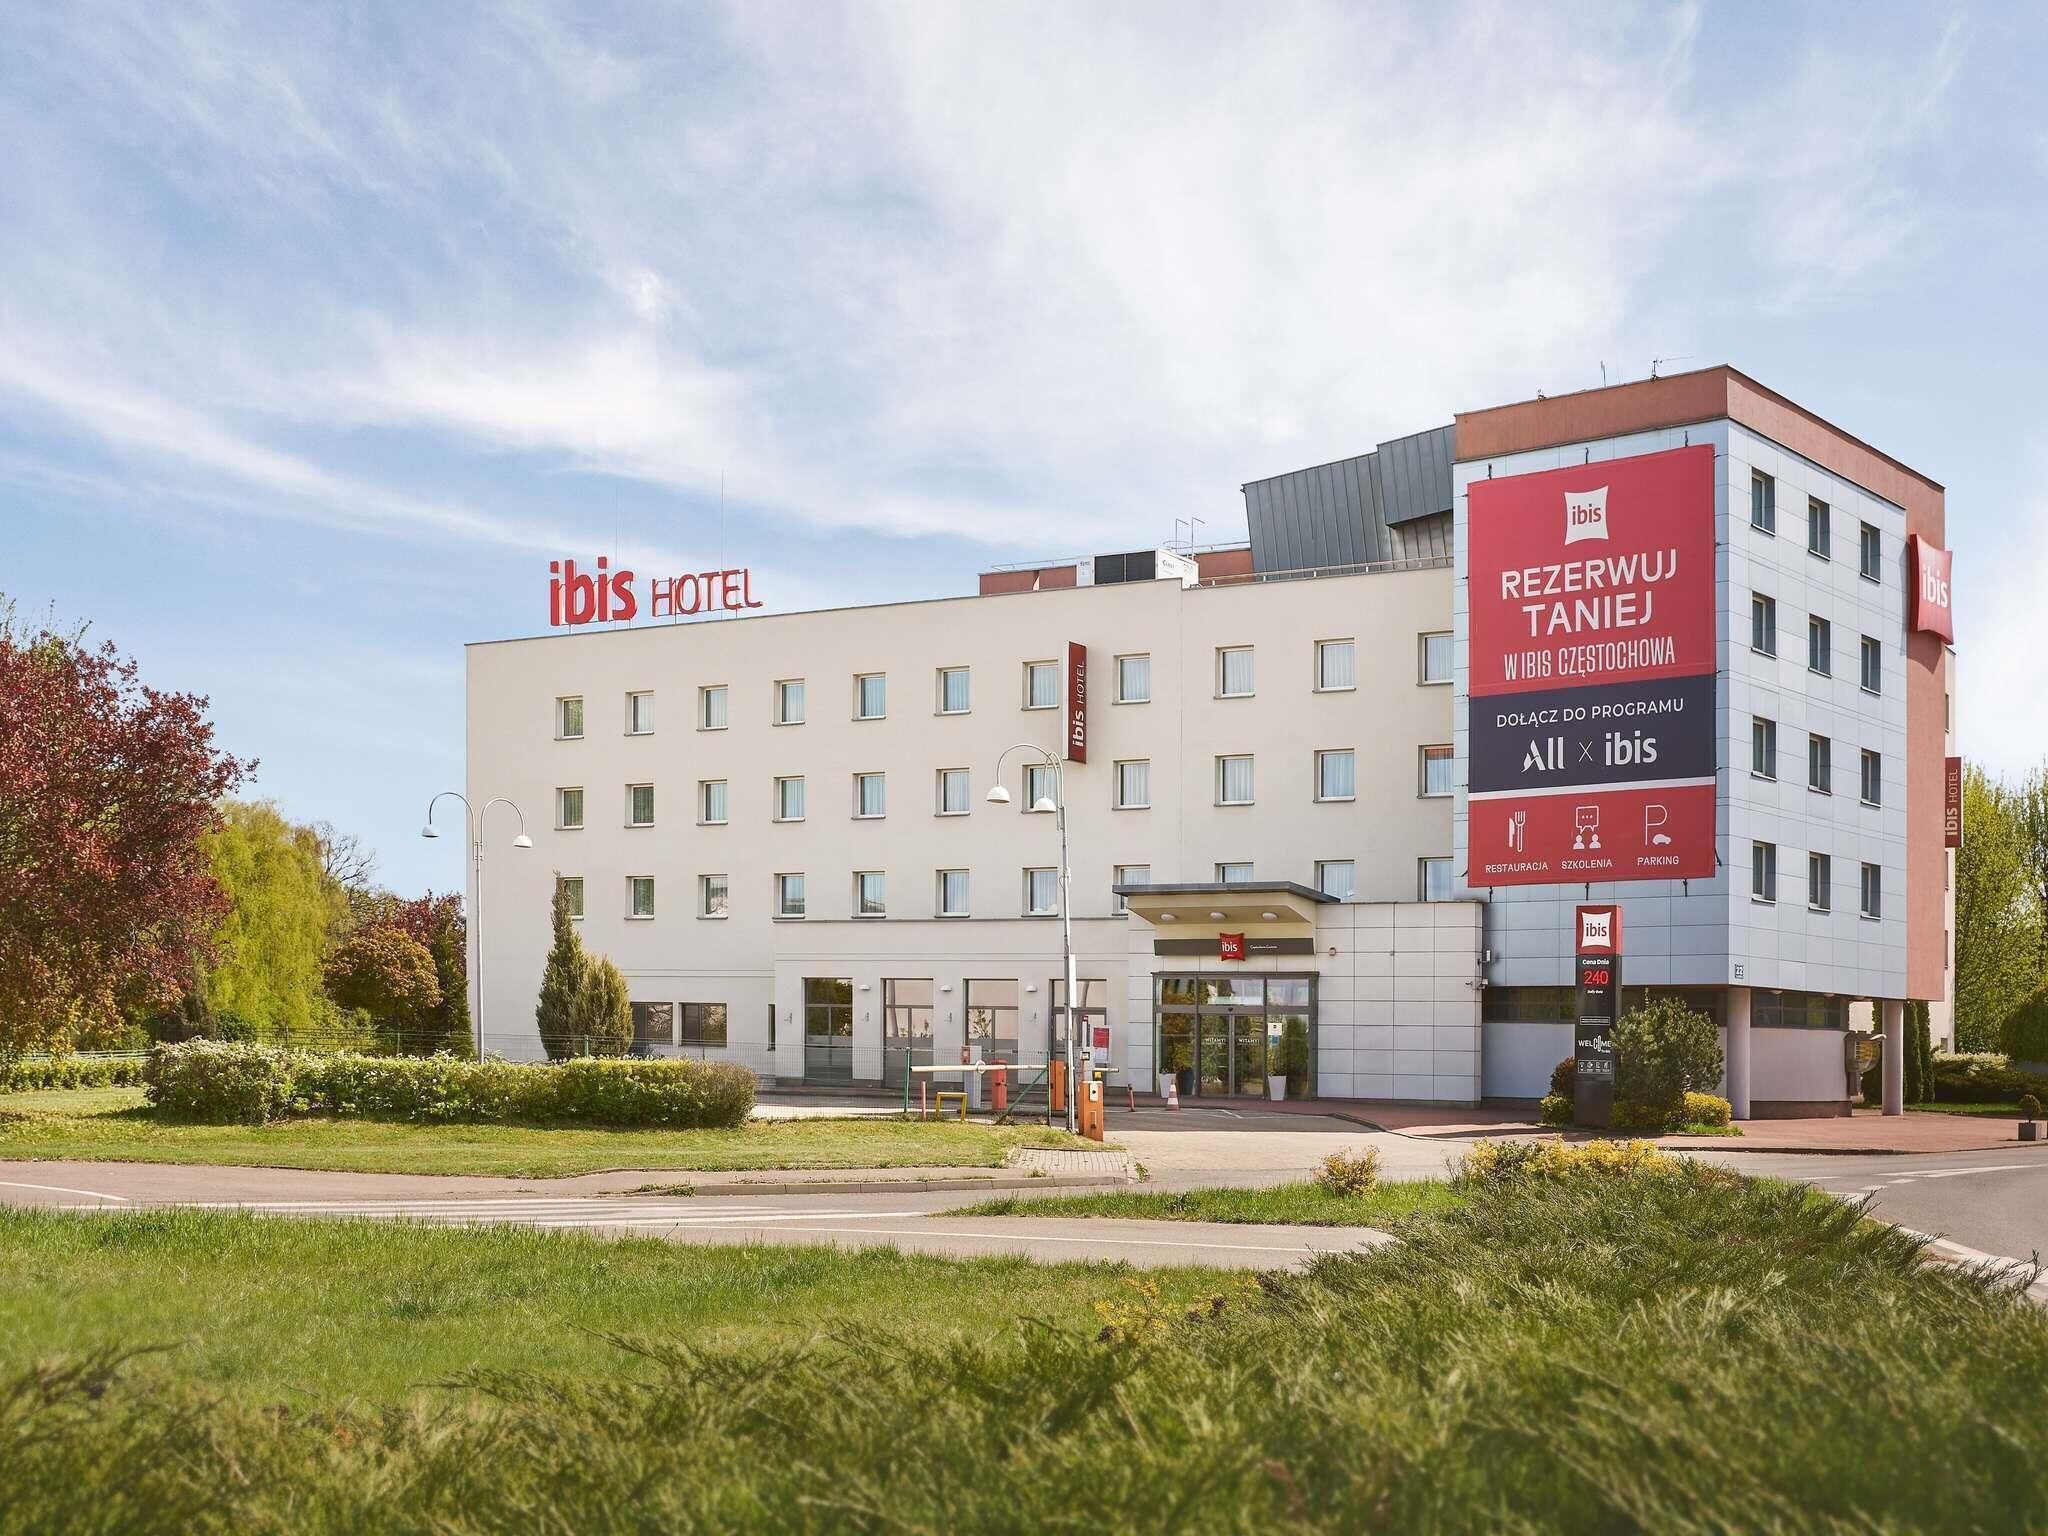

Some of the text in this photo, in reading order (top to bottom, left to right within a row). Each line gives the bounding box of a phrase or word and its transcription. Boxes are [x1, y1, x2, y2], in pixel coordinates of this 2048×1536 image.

[1572, 503, 1602, 526] ibis
[1501, 548, 1677, 600] REZERWUJ
[1923, 563, 1948, 609] ibis
[550, 556, 764, 626] ibis HOTEL
[1522, 590, 1652, 637] TANIEJ
[1520, 649, 1552, 679] IBIS
[1558, 636, 1676, 678] CZĘSTOCHOWA
[1073, 661, 1086, 747] ibis HOTEL
[1497, 697, 1684, 728] DOŁĄCZ DO PROGRAMU
[1605, 730, 1658, 766] ibis
[1949, 769, 1958, 803] HOTEL
[1485, 861, 1548, 873] RESTAURACJA
[1561, 858, 1612, 870] SZKOLENIA
[1637, 855, 1680, 866] PARKING
[1585, 922, 1607, 937] ibis
[1221, 941, 1238, 952] ibis
[1584, 970, 1609, 985] 240
